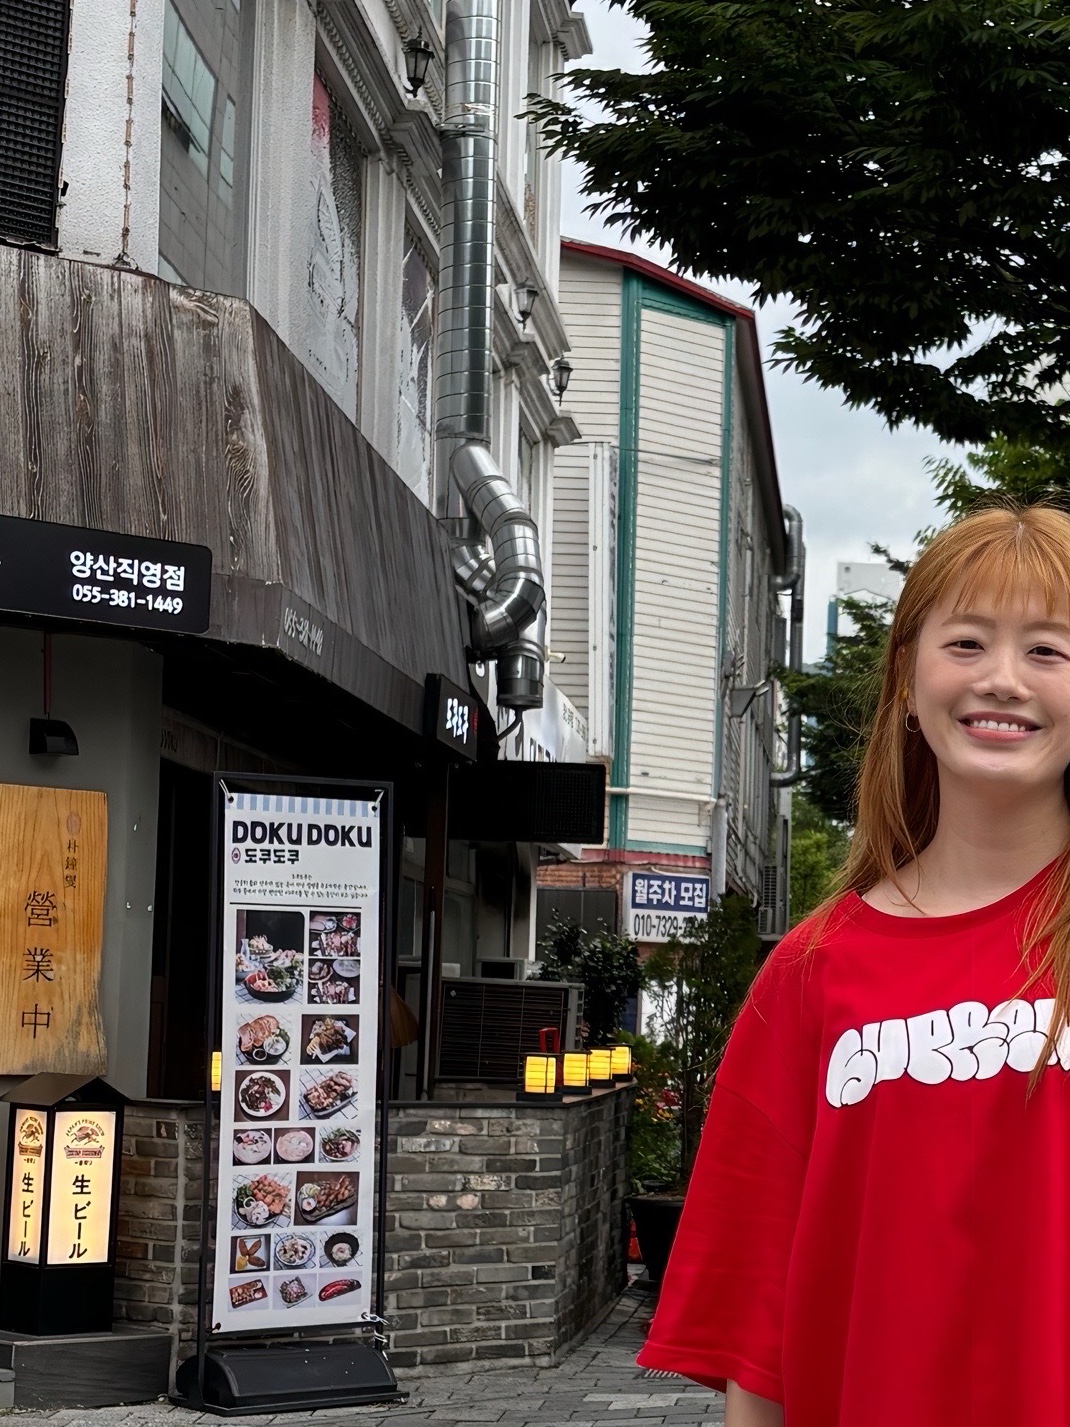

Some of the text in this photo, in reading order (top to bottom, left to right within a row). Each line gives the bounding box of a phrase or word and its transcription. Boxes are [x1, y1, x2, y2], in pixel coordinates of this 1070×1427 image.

[69, 550, 186, 592] 양산직영점
[72, 583, 184, 615] 055-381-1449
[232, 820, 372, 848] DOKU DOKU
[244, 848, 300, 864] 도쿠도쿠
[635, 878, 707, 908] 월주차 모집
[18, 1172, 34, 1257] 生ビール
[69, 1174, 92, 1259] 生ビール
